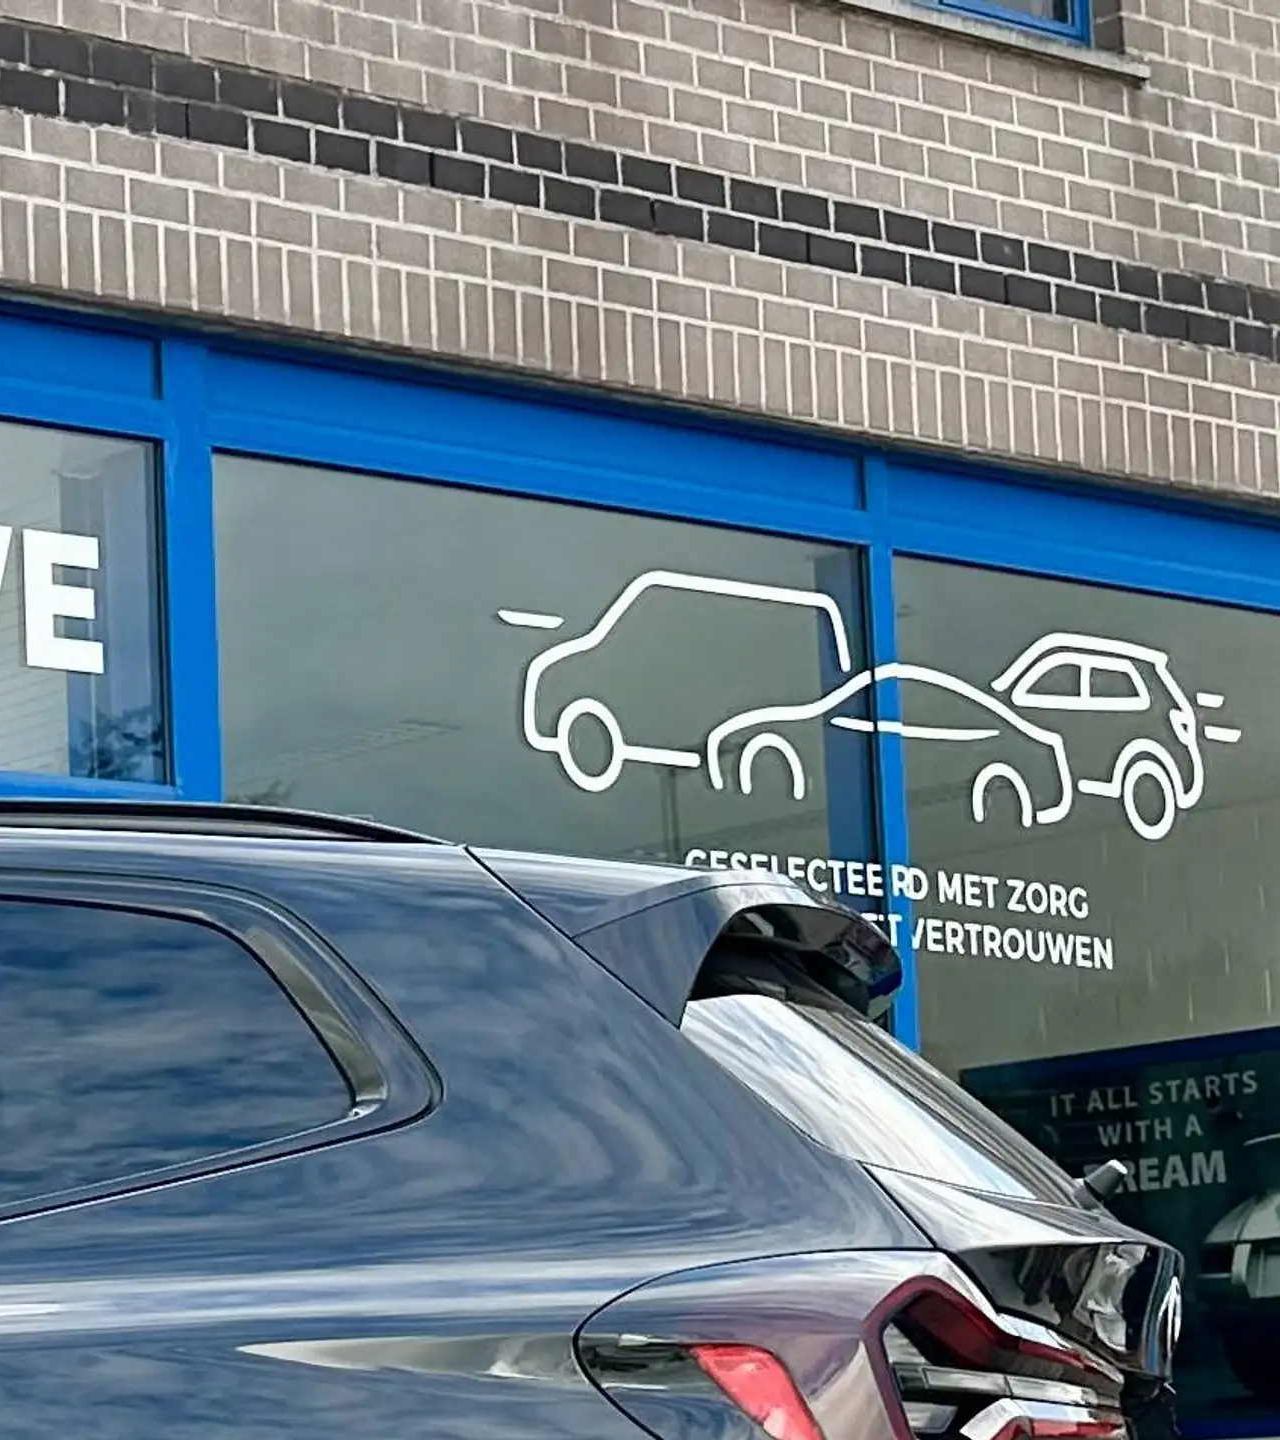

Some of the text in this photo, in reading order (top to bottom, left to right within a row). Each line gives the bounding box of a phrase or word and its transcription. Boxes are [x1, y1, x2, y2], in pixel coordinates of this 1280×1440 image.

[939, 870, 1000, 909] MET
[1004, 878, 1090, 919] ZORG
[910, 917, 1114, 970] VERTROUWEN
[1050, 1070, 1259, 1117] IT ALL STARTS
[1097, 1113, 1203, 1148] WITH A
[1083, 1149, 1228, 1194] REAM
